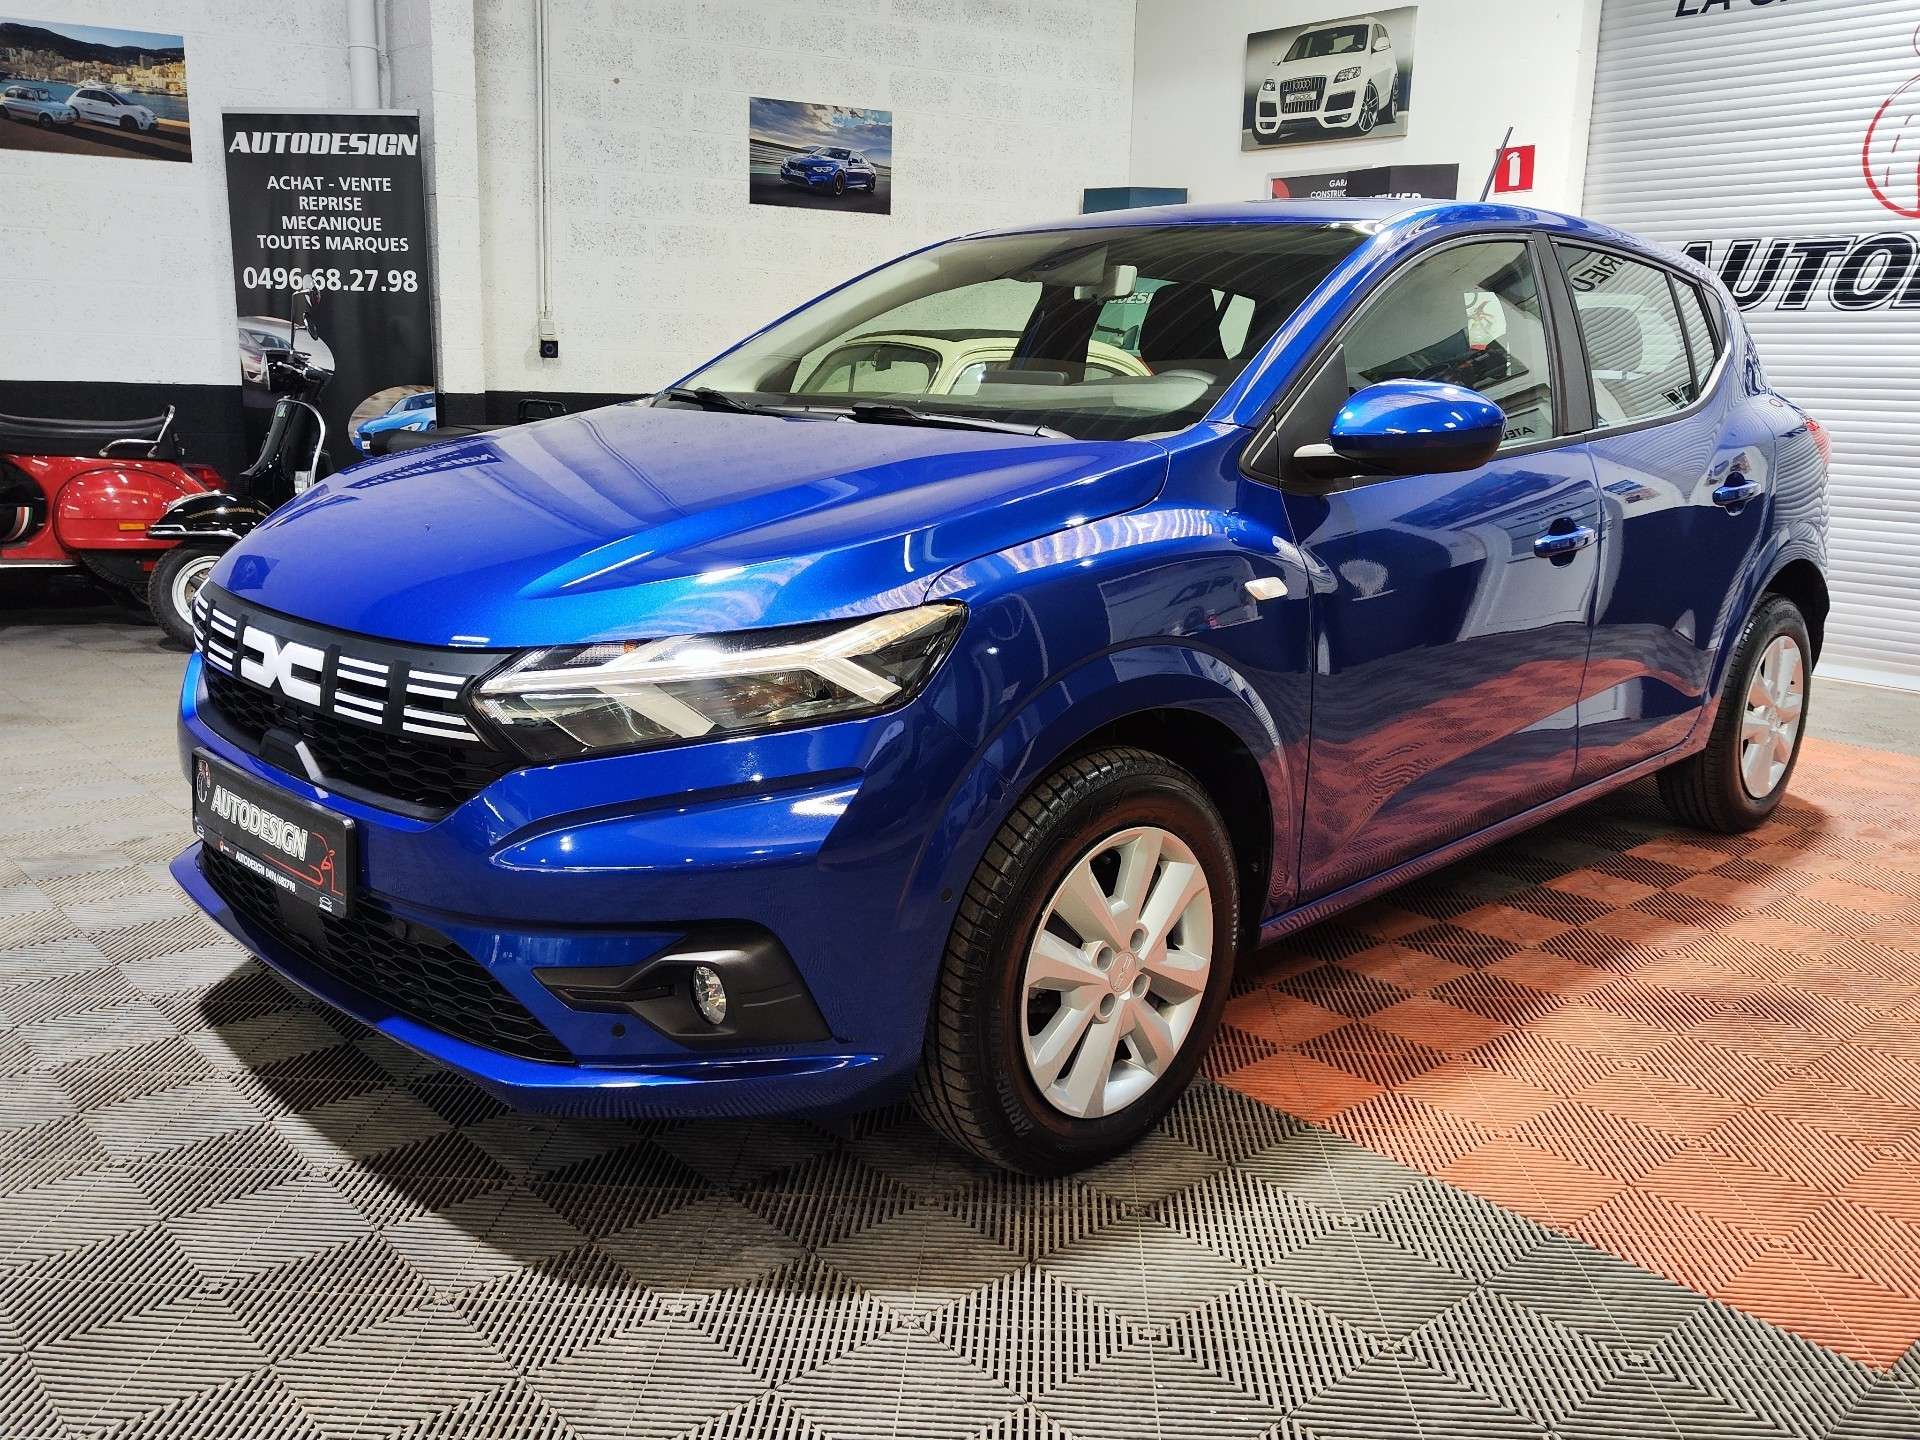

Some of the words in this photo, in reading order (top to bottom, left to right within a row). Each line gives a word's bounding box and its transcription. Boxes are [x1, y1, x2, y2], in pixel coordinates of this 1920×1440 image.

[228, 131, 419, 156] AUTODESIGN
[267, 175, 323, 191] ACHAT
[339, 176, 392, 192] VENTE
[299, 196, 363, 211] REPRISE
[281, 215, 382, 233] MECANIQUE
[256, 234, 321, 250] TOUTES
[325, 236, 409, 253] MARQUES
[210, 784, 309, 862] AUTODESIGN
